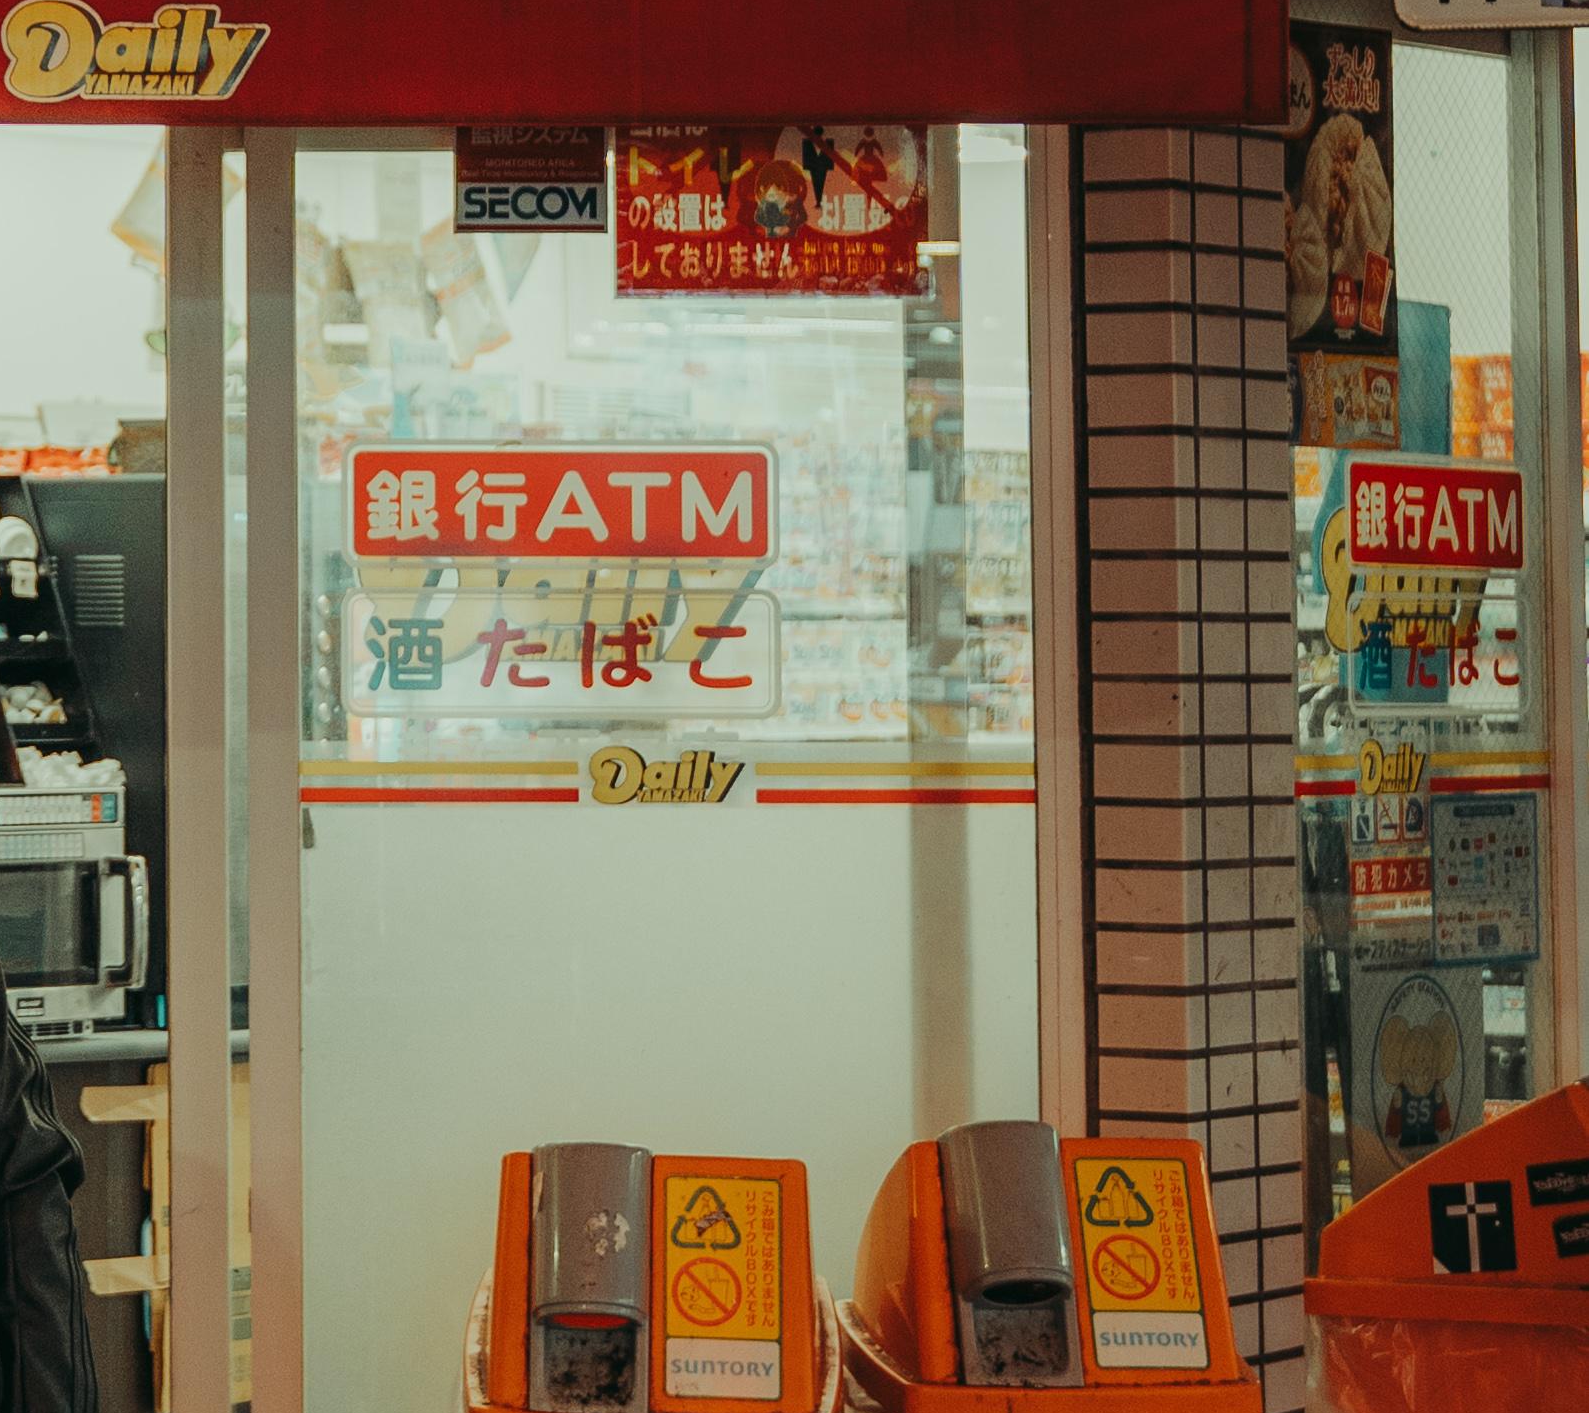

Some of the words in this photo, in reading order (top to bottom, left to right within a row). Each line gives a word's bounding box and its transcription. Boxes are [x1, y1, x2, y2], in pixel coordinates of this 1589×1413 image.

[4, 0, 267, 98] Daily
[85, 73, 195, 95] YAMAZAKI
[629, 146, 754, 187] トイレ
[464, 186, 598, 220] SECOM
[628, 193, 727, 232] の設置は
[632, 240, 799, 279] しておりません
[366, 469, 753, 543] 銀行ATM
[1355, 480, 1518, 555] 銀行ATM
[366, 615, 444, 691] 酒
[477, 613, 753, 689] たばこ
[1405, 619, 1520, 687] たばこ
[589, 745, 746, 804] Daily
[637, 788, 707, 803] YAMAZAKI
[1361, 739, 1427, 796] Daily
[744, 1190, 758, 1327] リサイクルBOXです
[760, 1190, 776, 1328] ごみ箱ではありません
[1152, 1169, 1178, 1300] リサイクルBOXです
[1168, 1169, 1196, 1305] ごみ箱ではありません
